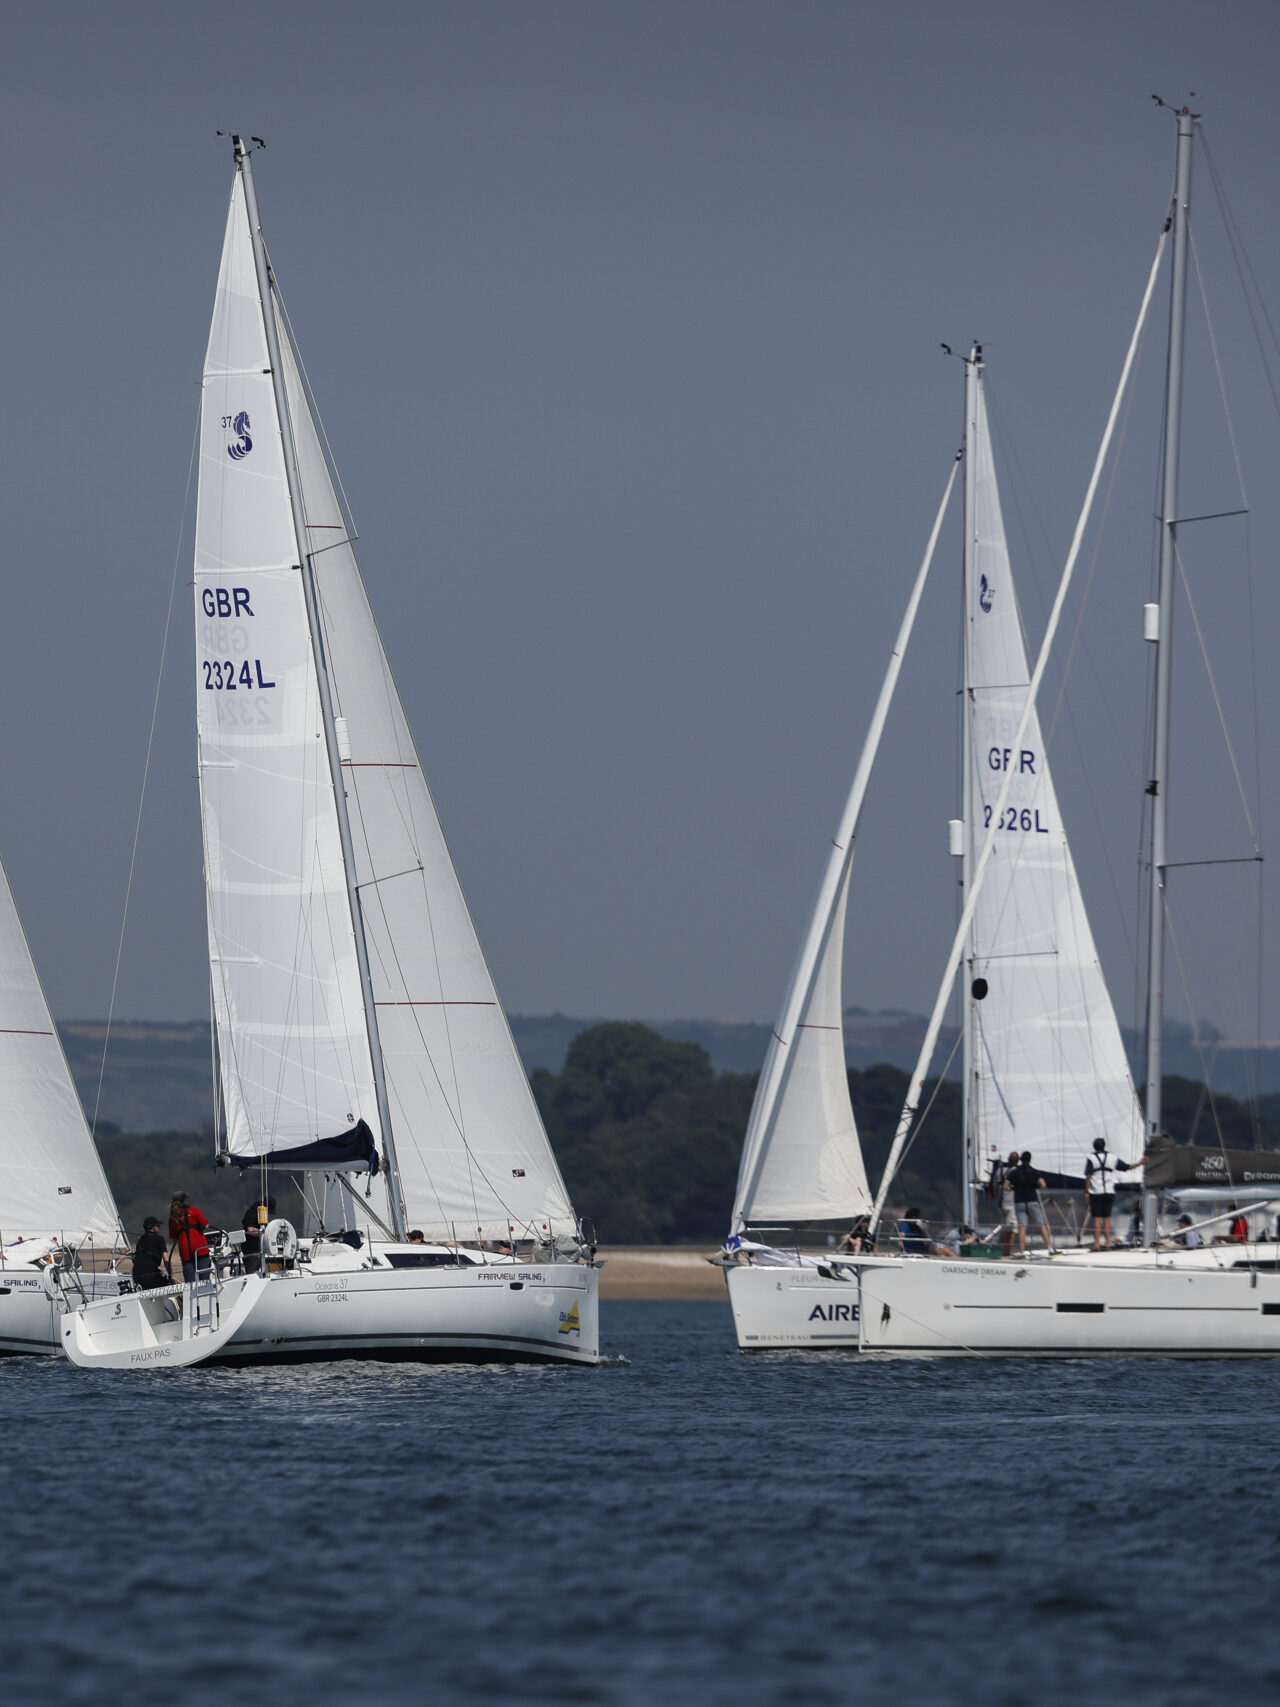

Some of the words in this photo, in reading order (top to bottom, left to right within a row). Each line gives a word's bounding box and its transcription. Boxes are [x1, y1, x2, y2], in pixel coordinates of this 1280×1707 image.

[221, 416, 232, 428] 37
[202, 587, 255, 618] GBR
[202, 659, 276, 690] 2324L
[478, 1273, 515, 1281] FAIRVIEW
[517, 1273, 542, 1281] SAILING
[3, 1279, 38, 1287] SAILING
[339, 1278, 348, 1289] 37
[317, 1294, 330, 1303] GBR
[130, 1351, 153, 1364] FAUX
[154, 1348, 171, 1360] PAS
